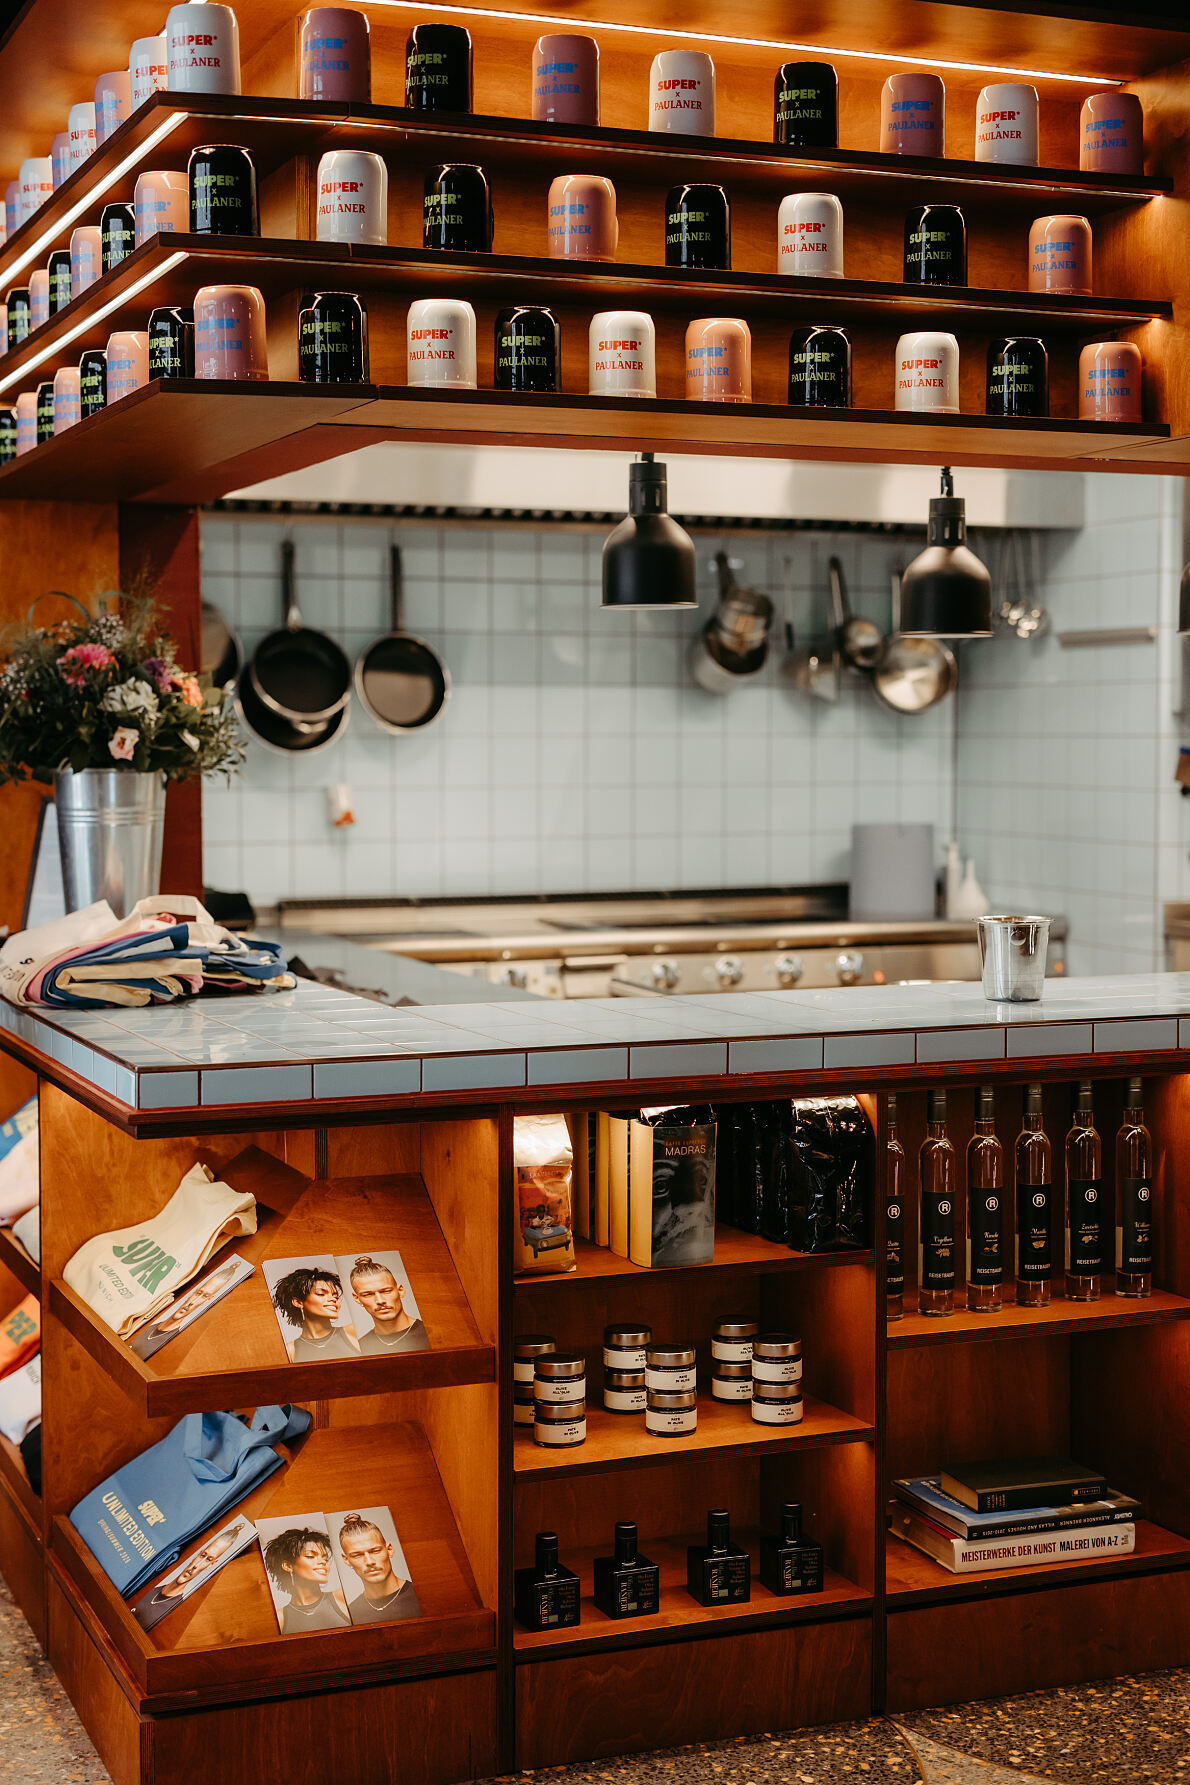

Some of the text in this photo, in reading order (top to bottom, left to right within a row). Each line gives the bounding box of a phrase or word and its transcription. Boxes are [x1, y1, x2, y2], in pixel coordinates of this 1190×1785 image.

[171, 57, 220, 69] PAULANER
[405, 75, 448, 88] PAULANER
[535, 84, 580, 97] PAULANER
[654, 100, 702, 111] PAULANER
[776, 109, 822, 122] PAULANER
[888, 120, 935, 132] PAULANER
[978, 130, 1022, 143] PAULANER
[1083, 138, 1127, 152] PAULANER
[192, 197, 242, 209] PAULANER
[319, 204, 366, 216] PAULANER
[548, 225, 591, 236] PAULANER
[666, 232, 711, 244] PAULANER
[782, 243, 827, 255] PAULANER
[906, 251, 952, 263] PAULANER
[1032, 261, 1076, 273] PAULANER
[301, 343, 348, 355] PAULANER
[409, 350, 455, 360] PAULANER
[500, 356, 547, 366] PAULANER
[596, 360, 643, 371] PAULANER
[687, 367, 729, 378] PAULANER
[791, 372, 836, 382] PAULANER
[899, 379, 944, 389] PAULANER
[990, 384, 1034, 394] PAULANER
[1085, 388, 1130, 398] PAULANER
[665, 1145, 706, 1156] MADRAS
[102, 1491, 156, 1561] UNLIMITED EDITION
[962, 1546, 1016, 1562] MEISTERWERKE
[1018, 1545, 1032, 1557] DER
[1034, 1542, 1056, 1555] KUNST
[1060, 1539, 1089, 1552] MALEREI
[1092, 1537, 1105, 1548] VON
[1108, 1536, 1118, 1546] A-Z
